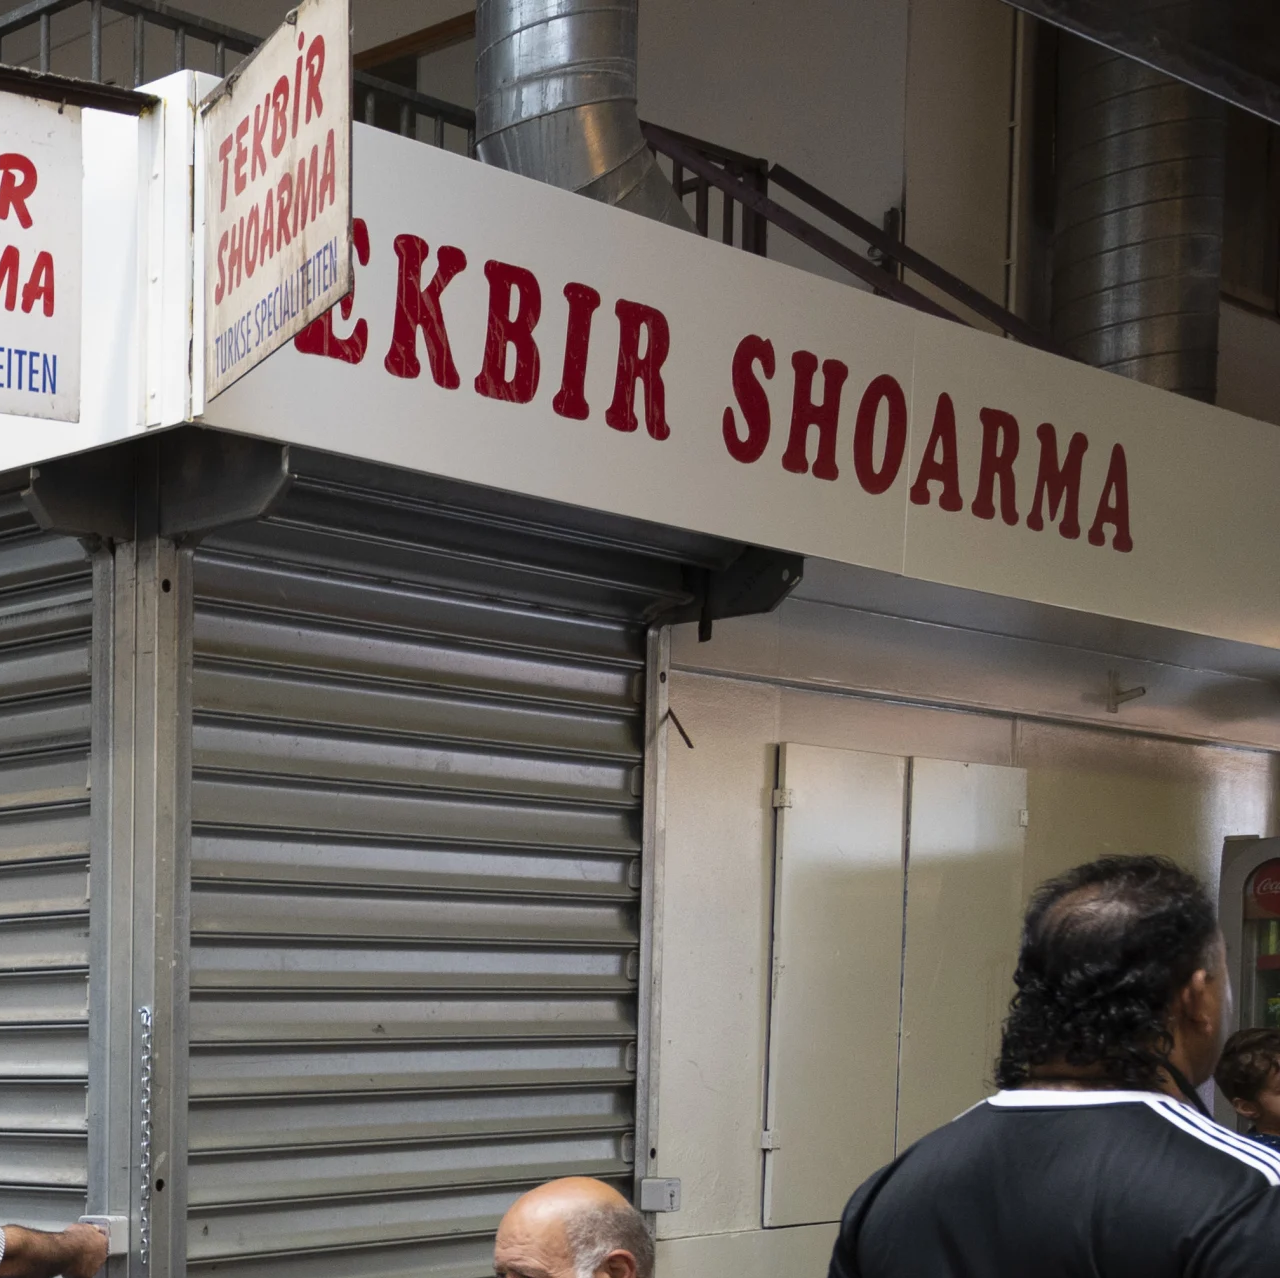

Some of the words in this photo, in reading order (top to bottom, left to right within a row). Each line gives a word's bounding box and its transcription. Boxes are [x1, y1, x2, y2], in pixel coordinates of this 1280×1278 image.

[214, 128, 336, 306] SHOARMA
[215, 310, 251, 380] TURKSE
[255, 236, 338, 347] SPECIALITEITEN
[294, 218, 671, 442] EKBIR
[723, 333, 1133, 553] SHOARMA
